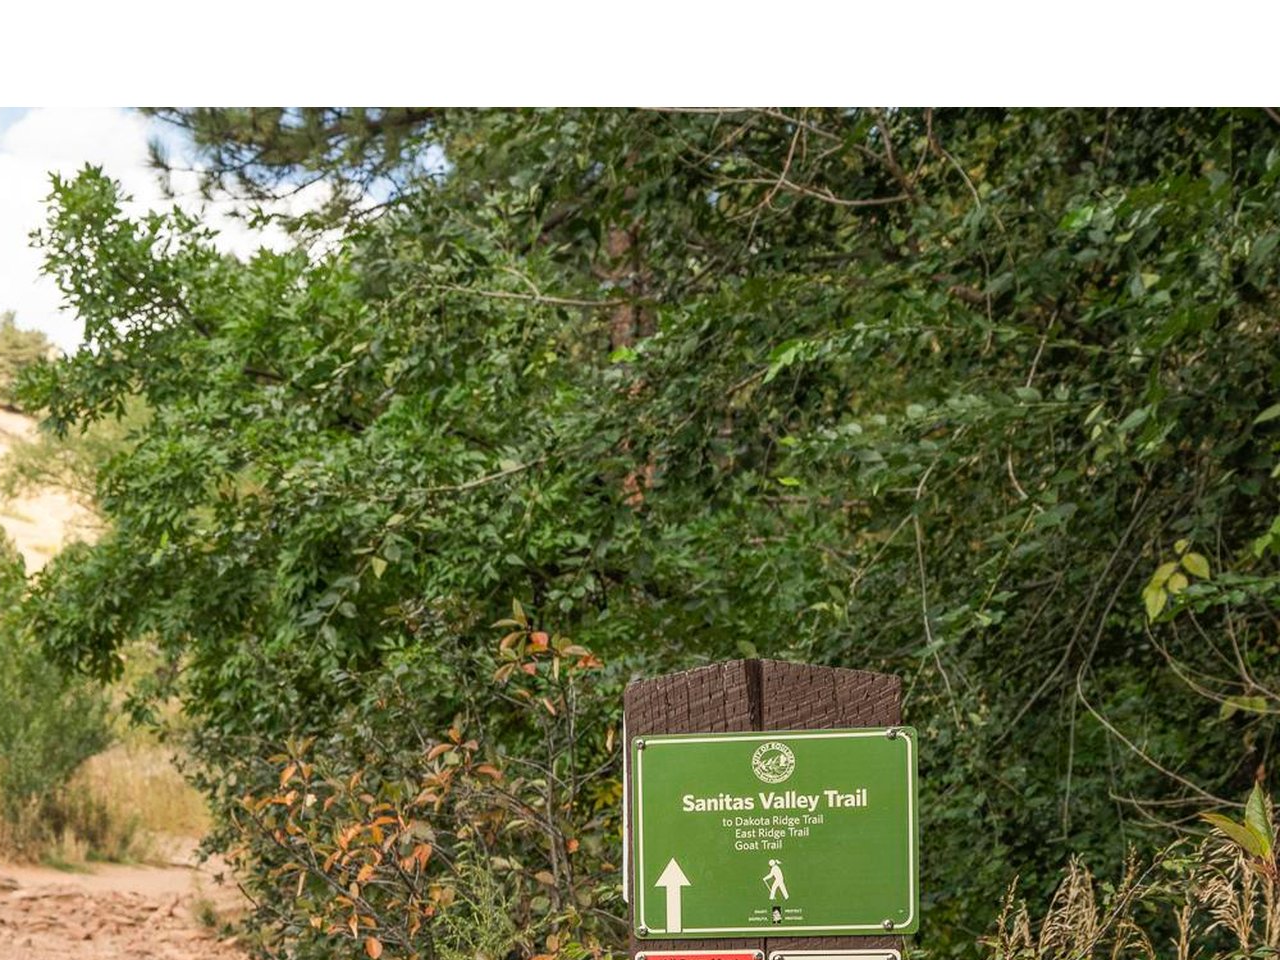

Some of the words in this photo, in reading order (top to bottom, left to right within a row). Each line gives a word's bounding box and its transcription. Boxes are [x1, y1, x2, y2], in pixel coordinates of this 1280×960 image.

[682, 793, 754, 812] Sanitas
[758, 791, 819, 812] Valley
[823, 788, 867, 808] Trail
[722, 818, 733, 827] to
[735, 816, 770, 827] Dakota
[772, 815, 800, 827] Ridge
[802, 814, 824, 825] Trail
[735, 829, 756, 839] East
[758, 827, 786, 840] Ridge
[788, 827, 810, 837] Trail
[734, 840, 759, 851] Goat
[761, 839, 783, 850] Trail
